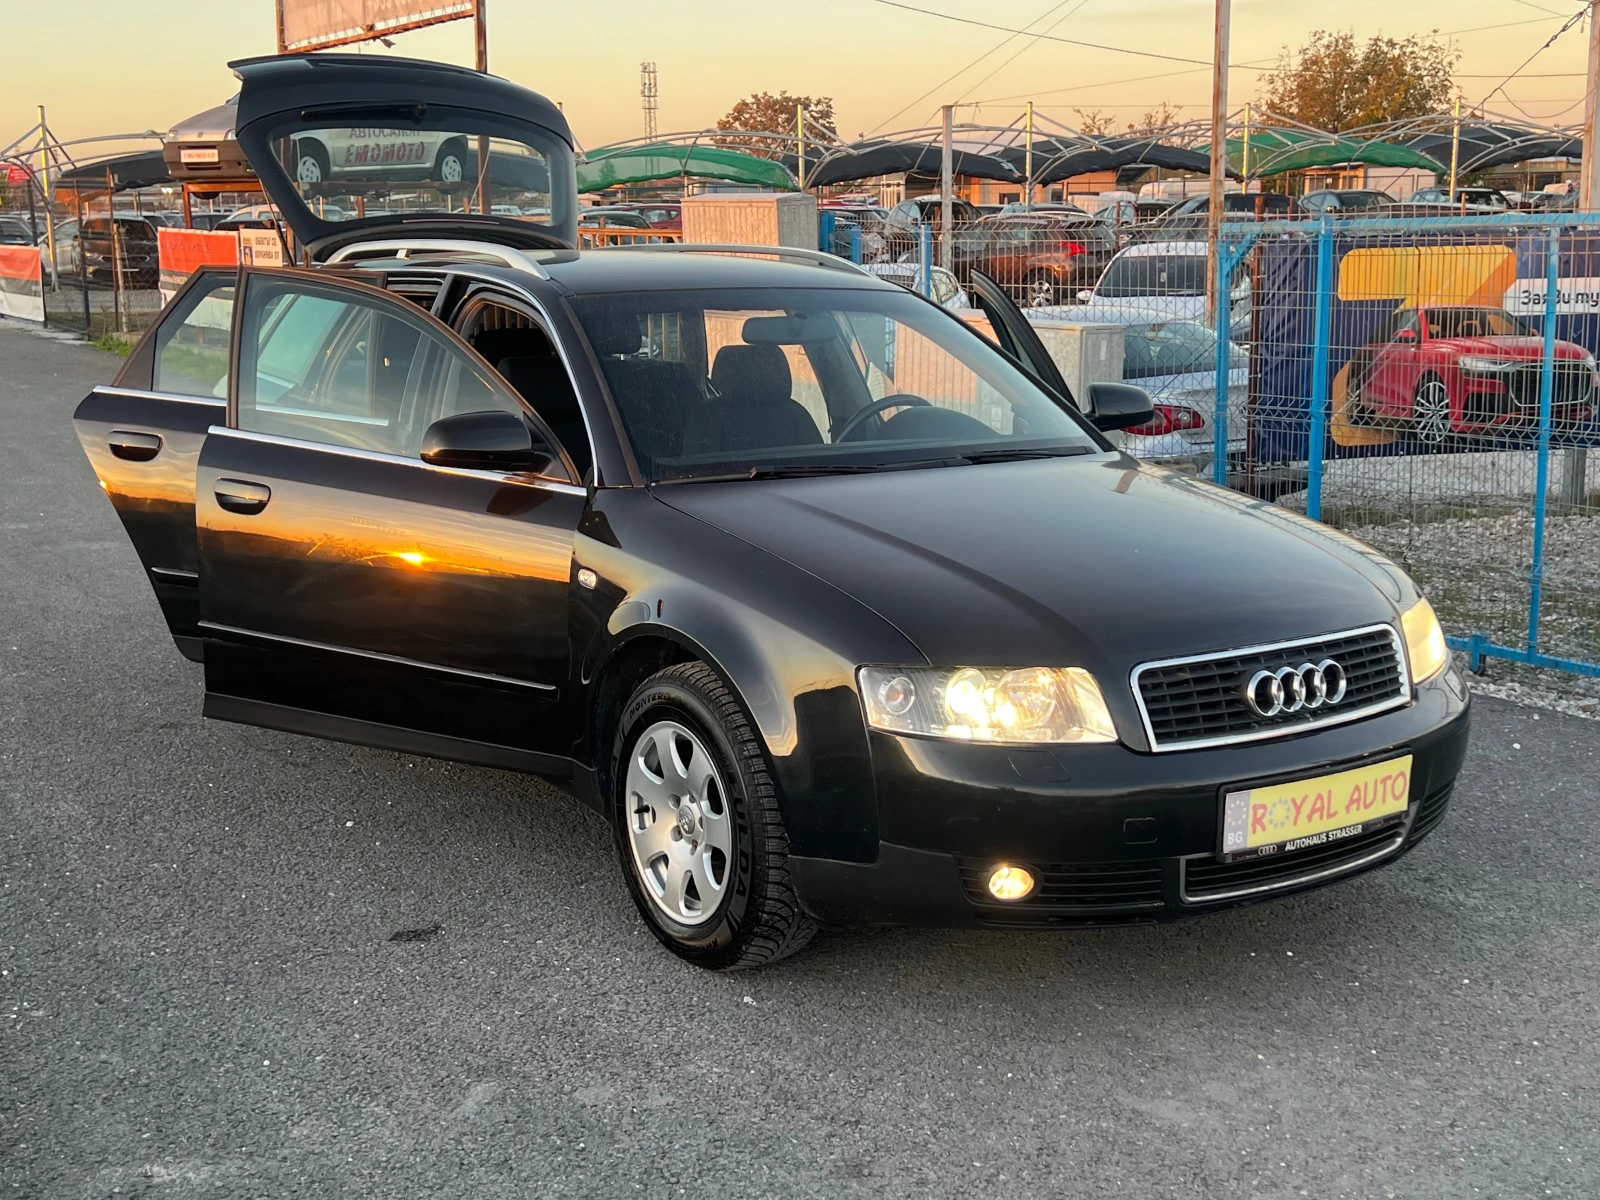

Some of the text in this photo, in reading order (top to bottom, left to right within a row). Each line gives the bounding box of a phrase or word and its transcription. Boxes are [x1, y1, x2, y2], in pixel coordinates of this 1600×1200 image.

[1345, 770, 1408, 814] AUTO
[1227, 830, 1244, 846] BG
[1285, 824, 1363, 851] AUTOHAUS STRASSER
